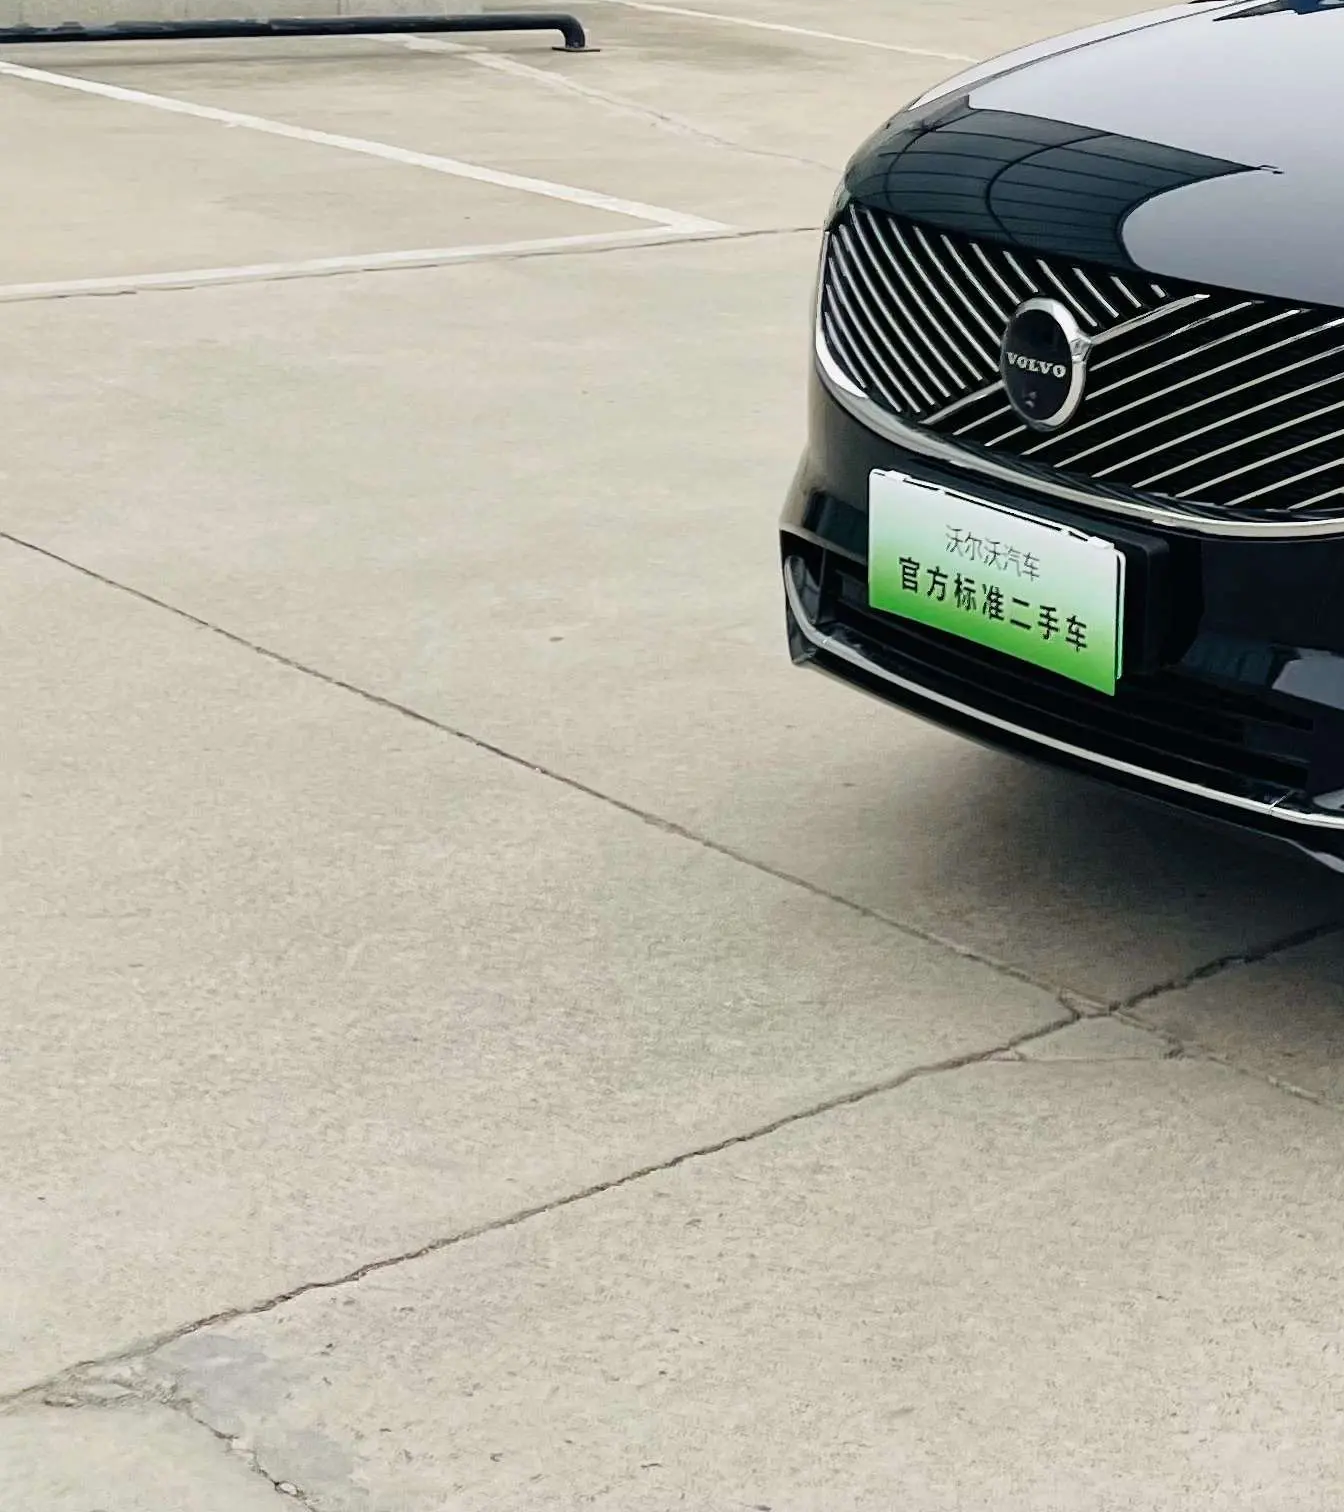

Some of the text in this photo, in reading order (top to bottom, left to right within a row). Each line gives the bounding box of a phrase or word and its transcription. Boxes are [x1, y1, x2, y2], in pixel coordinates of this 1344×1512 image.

[1006, 351, 1067, 378] VOLVO
[945, 524, 1041, 582] 沃尔沃汽车
[898, 555, 1089, 653] 官方标准二手车
